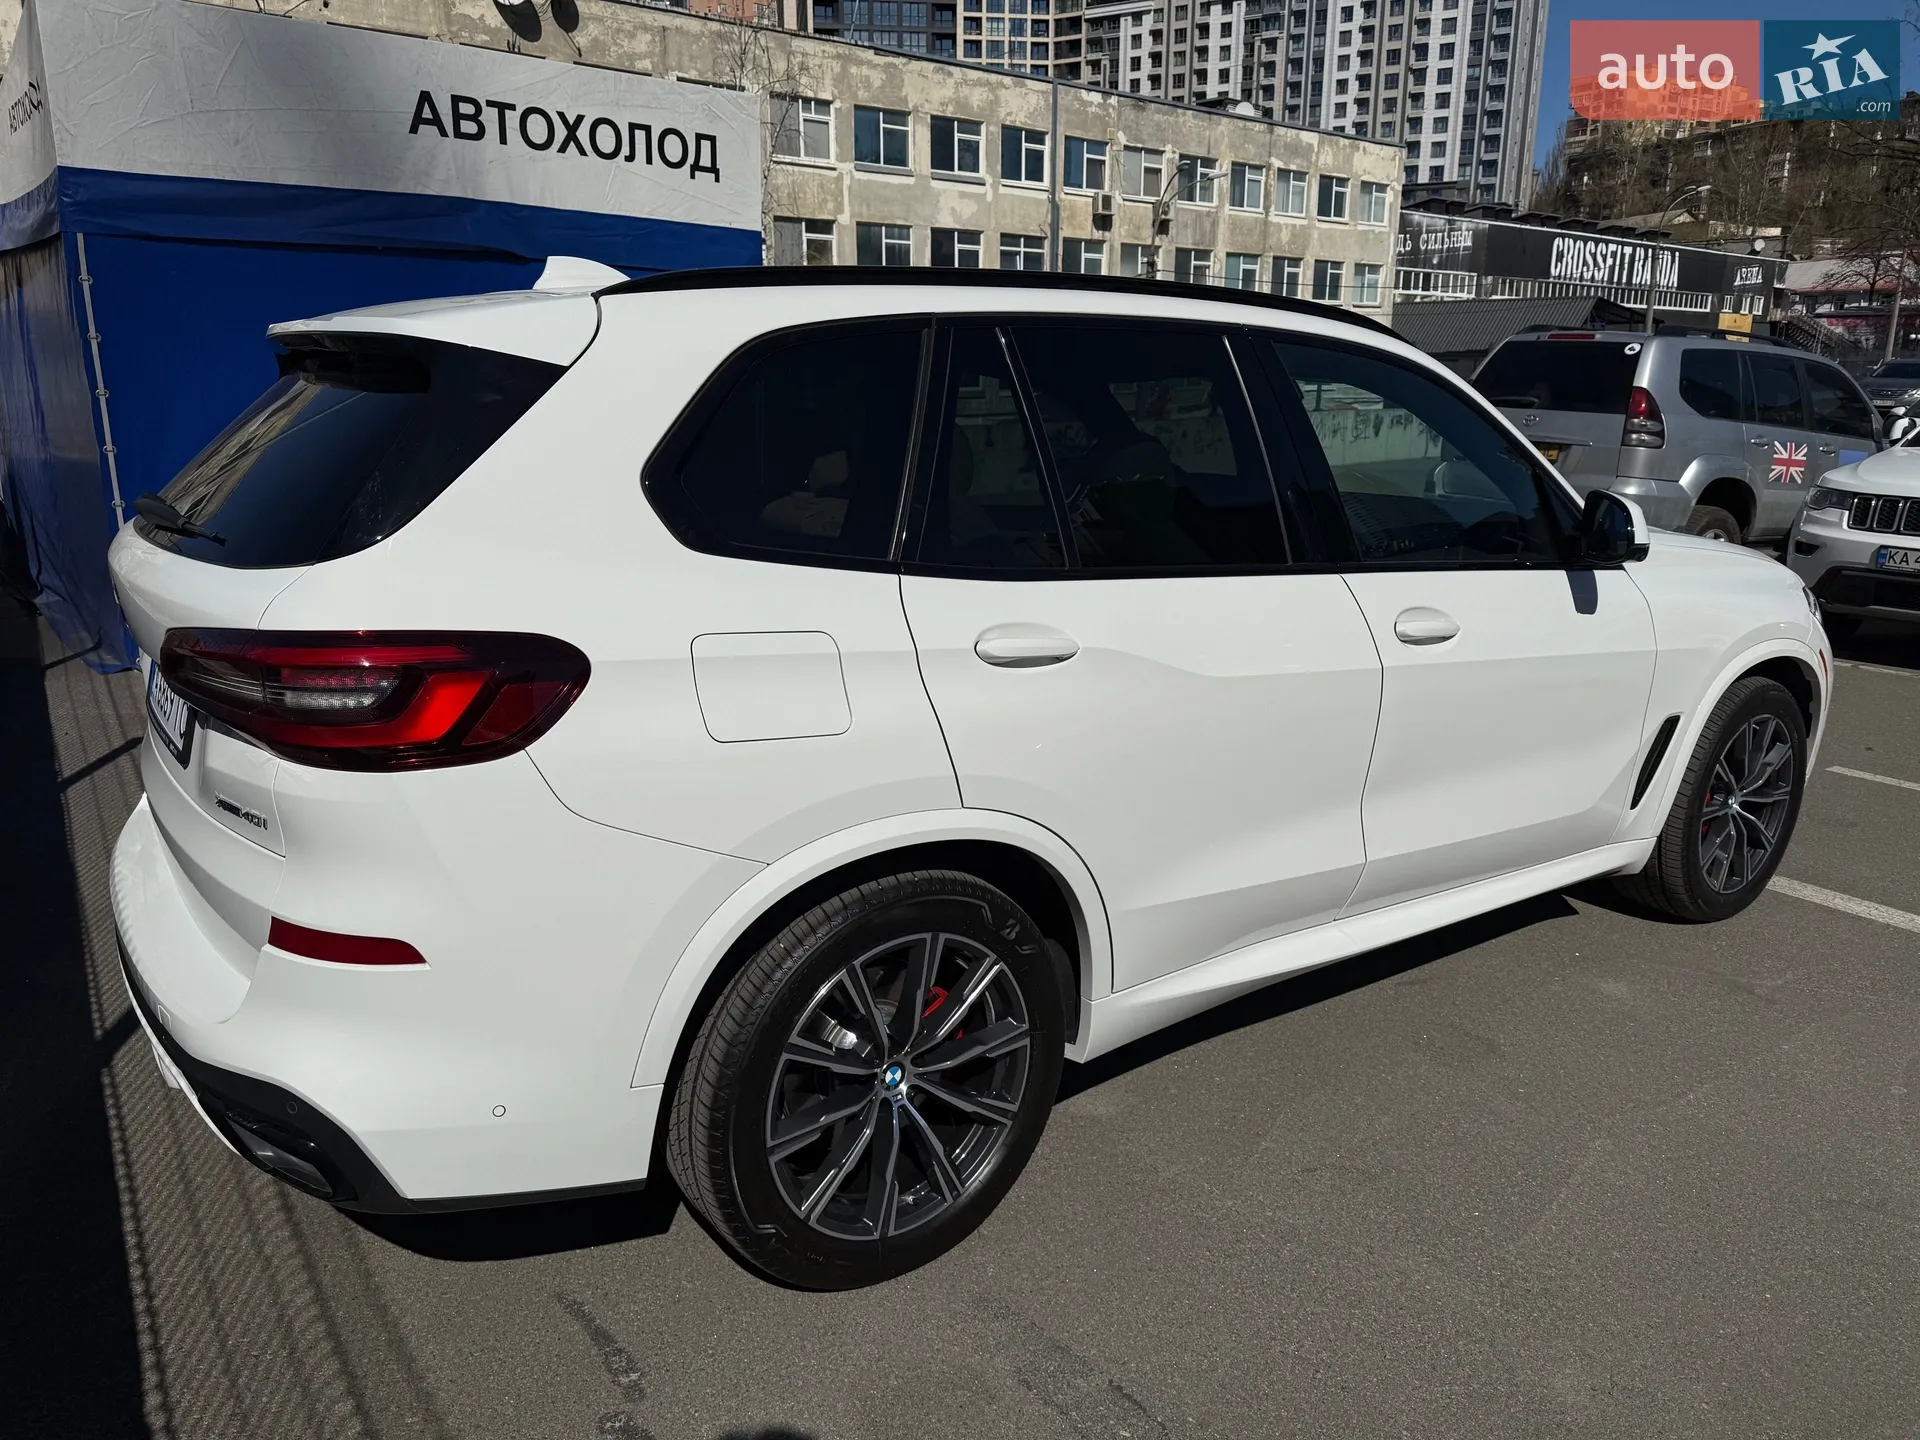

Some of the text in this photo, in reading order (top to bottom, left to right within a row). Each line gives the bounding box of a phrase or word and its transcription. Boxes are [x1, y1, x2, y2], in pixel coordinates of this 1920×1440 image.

[408, 89, 720, 183] АВТОХОЛОД
[1550, 237, 1633, 286] CROSSFIT
[1887, 550, 1909, 566] KA
